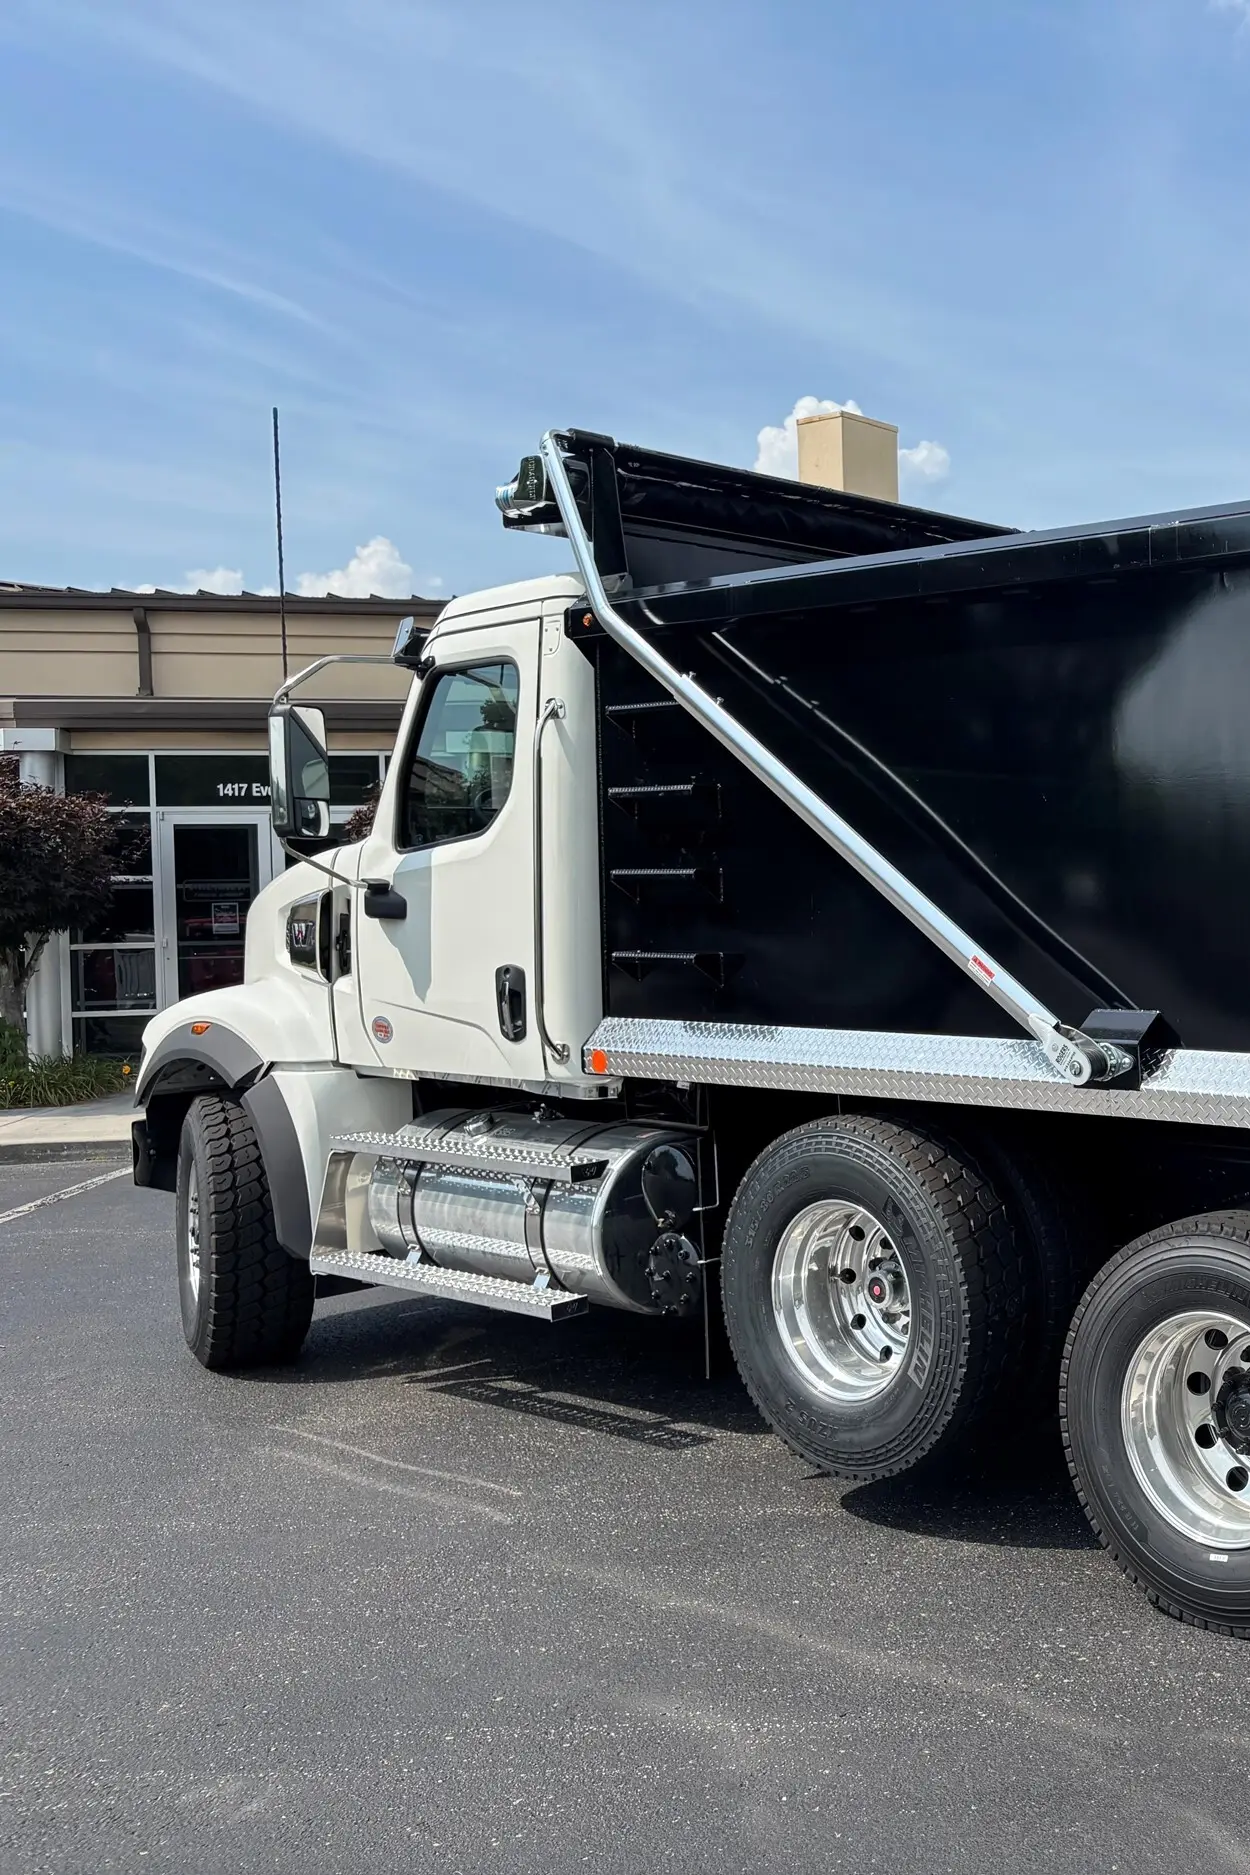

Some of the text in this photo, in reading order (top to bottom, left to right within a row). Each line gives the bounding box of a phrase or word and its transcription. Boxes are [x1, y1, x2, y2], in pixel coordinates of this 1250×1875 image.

[216, 782, 249, 797] 1417
[1055, 1043, 1070, 1066] ROGERS
[1165, 1275, 1250, 1302] MICHELIN
[906, 1237, 934, 1389] MICHELIN
